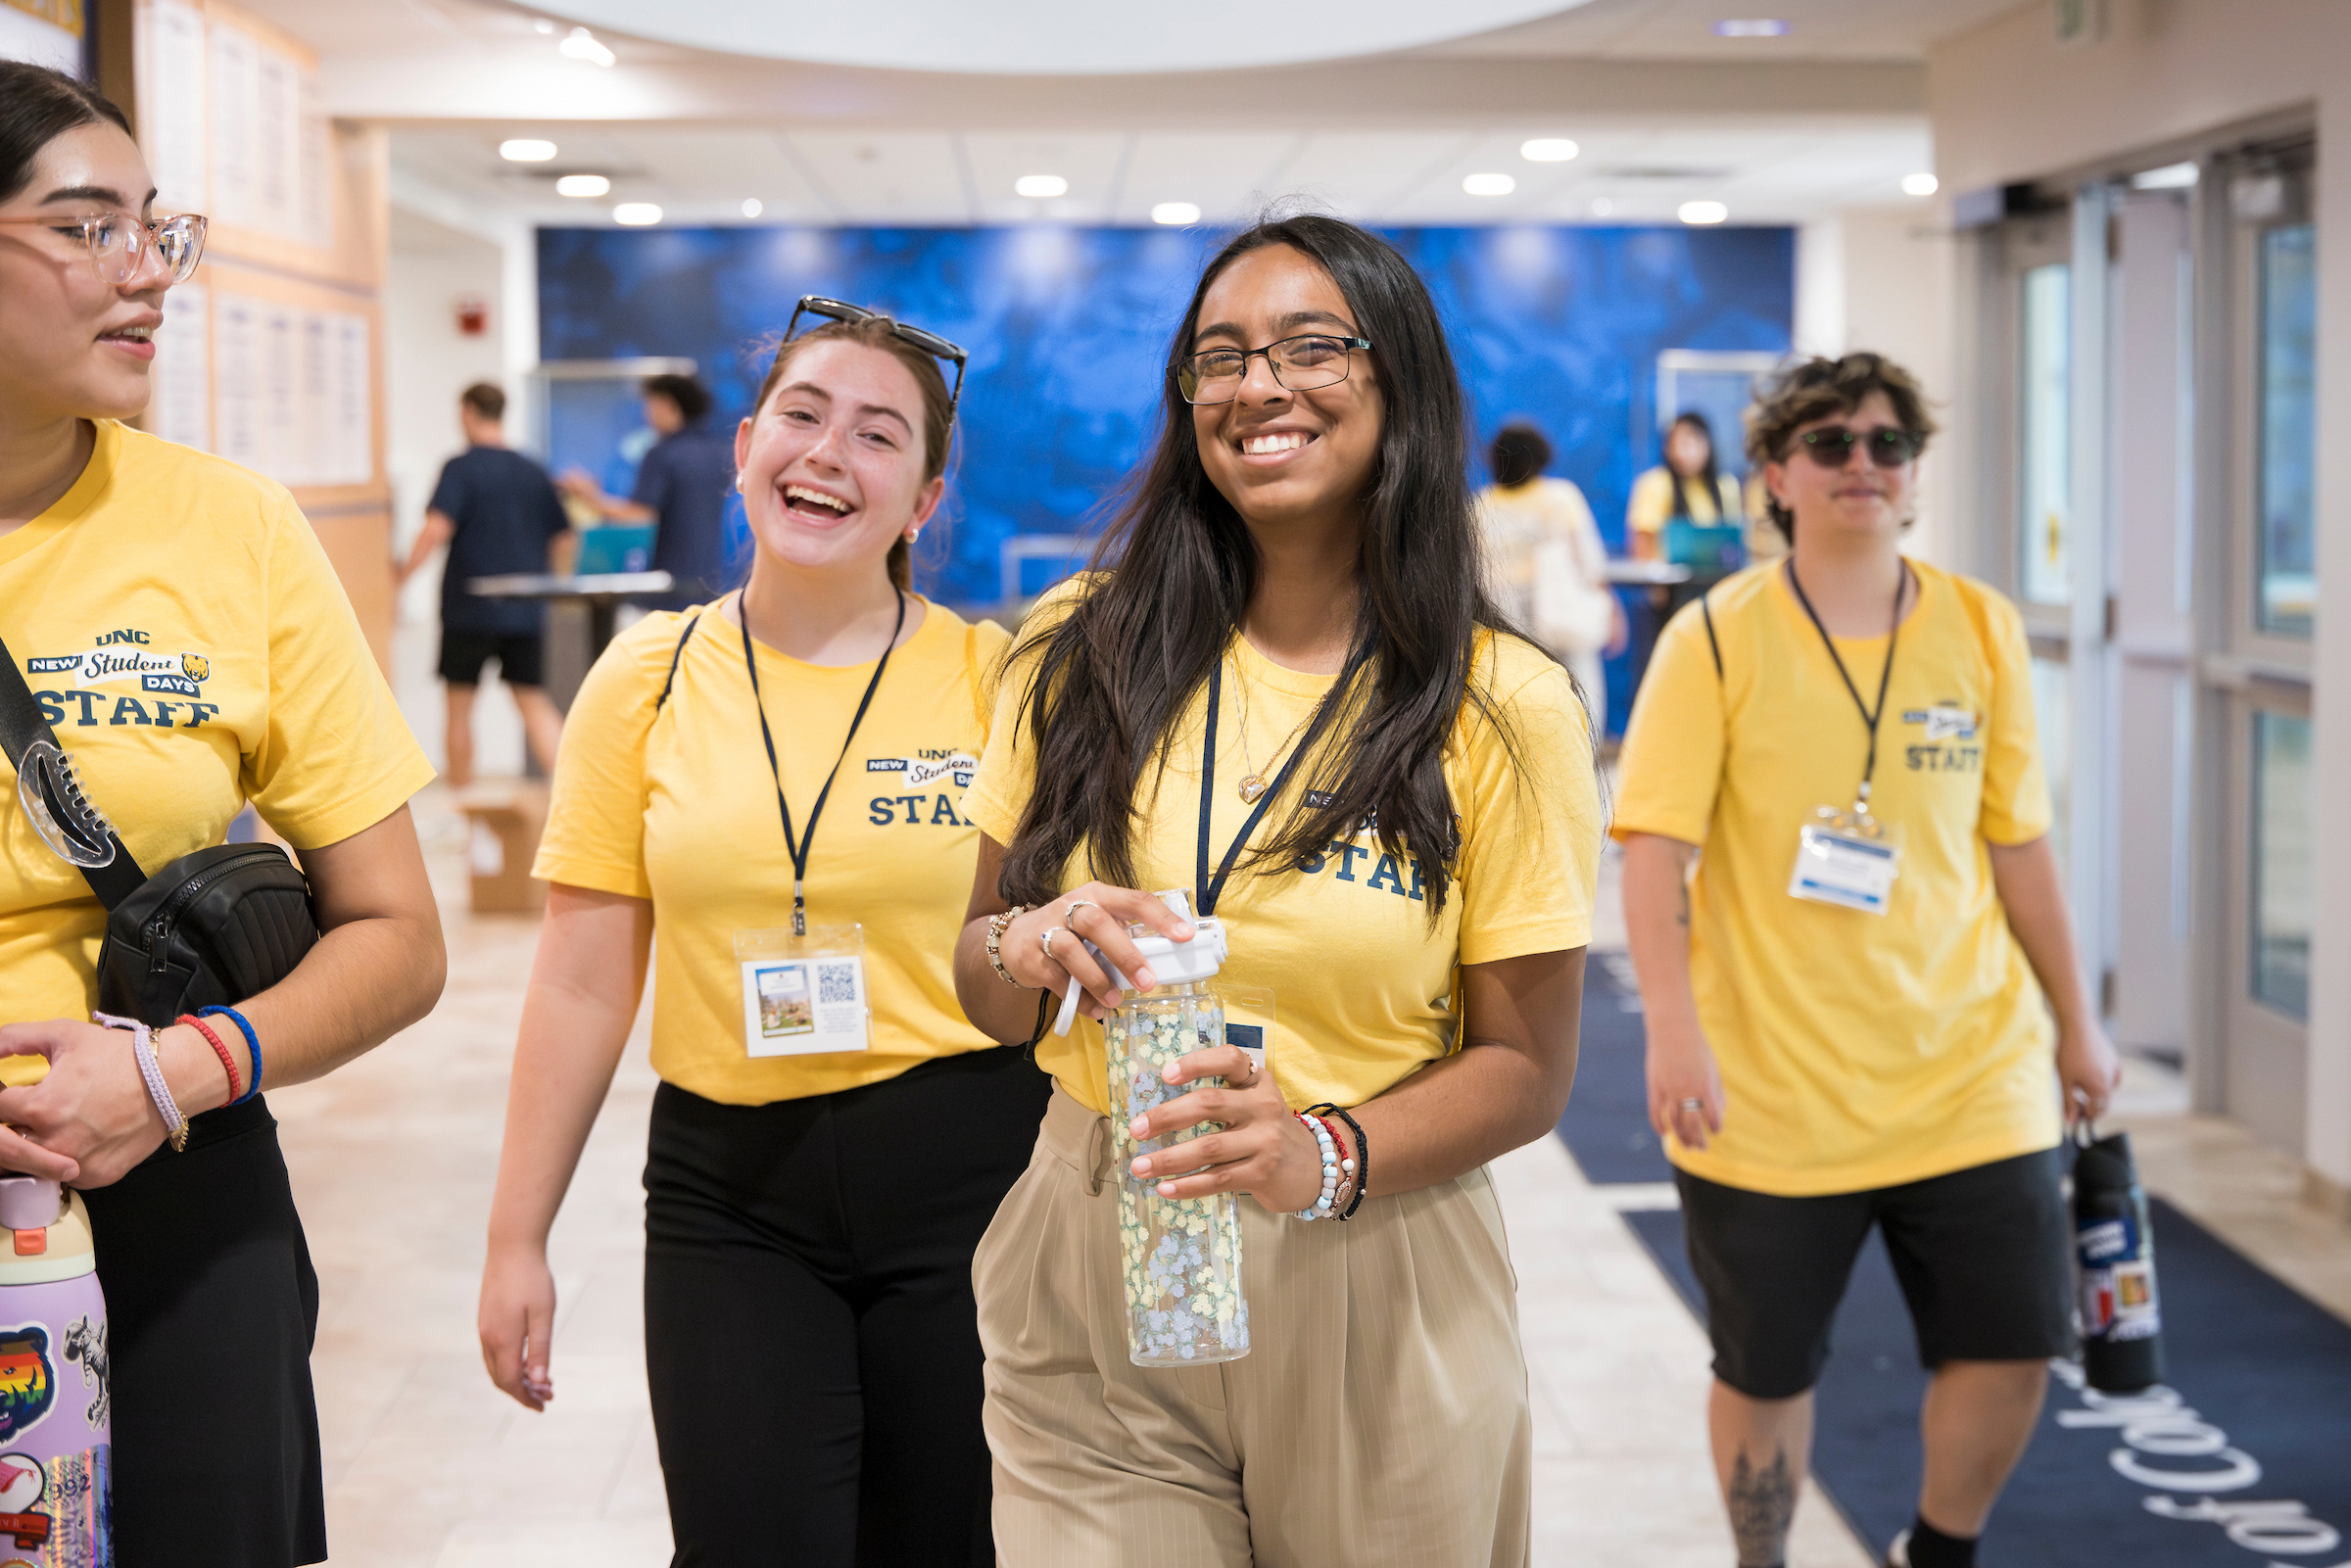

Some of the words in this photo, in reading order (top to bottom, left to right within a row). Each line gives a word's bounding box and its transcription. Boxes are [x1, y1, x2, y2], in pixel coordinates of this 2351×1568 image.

[96, 629, 150, 646] UNC
[31, 658, 77, 671] NEW
[84, 652, 176, 679] Student
[147, 677, 196, 693] DAYS
[33, 689, 219, 728] STAFF
[869, 761, 904, 771] NEW
